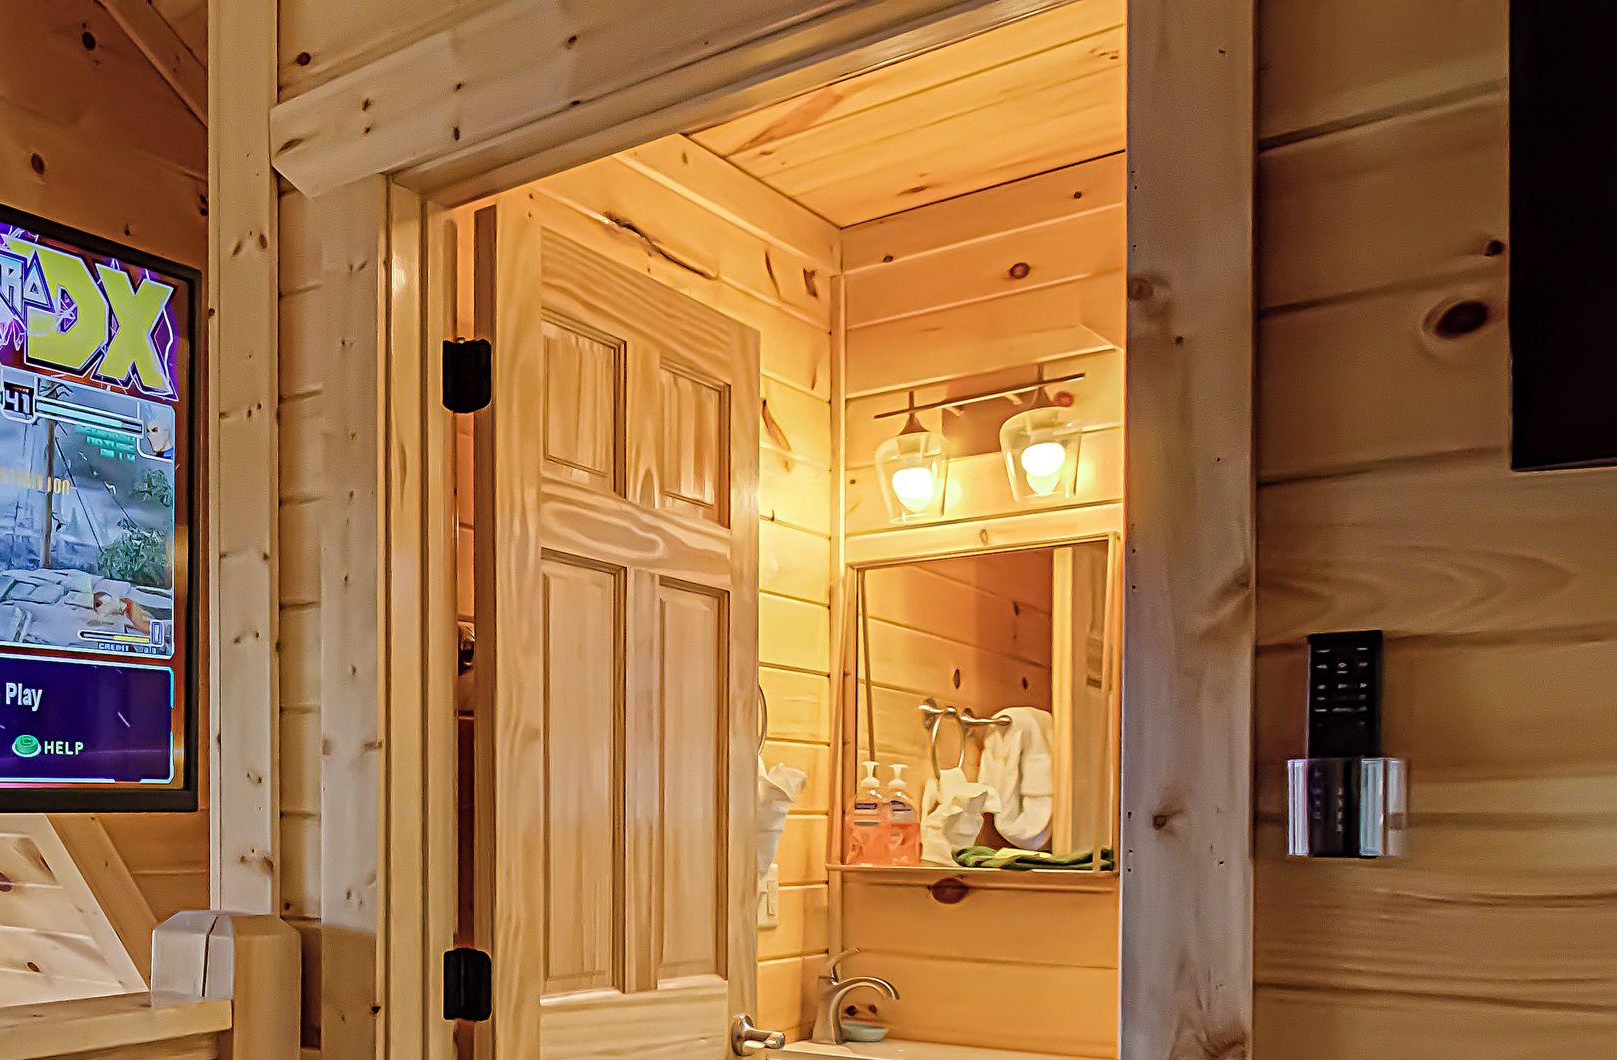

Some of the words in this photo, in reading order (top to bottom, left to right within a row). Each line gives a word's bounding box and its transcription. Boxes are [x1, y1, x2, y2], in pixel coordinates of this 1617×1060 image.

[3, 234, 177, 396] DX
[5, 682, 43, 712] Play
[44, 740, 84, 755] HELP
